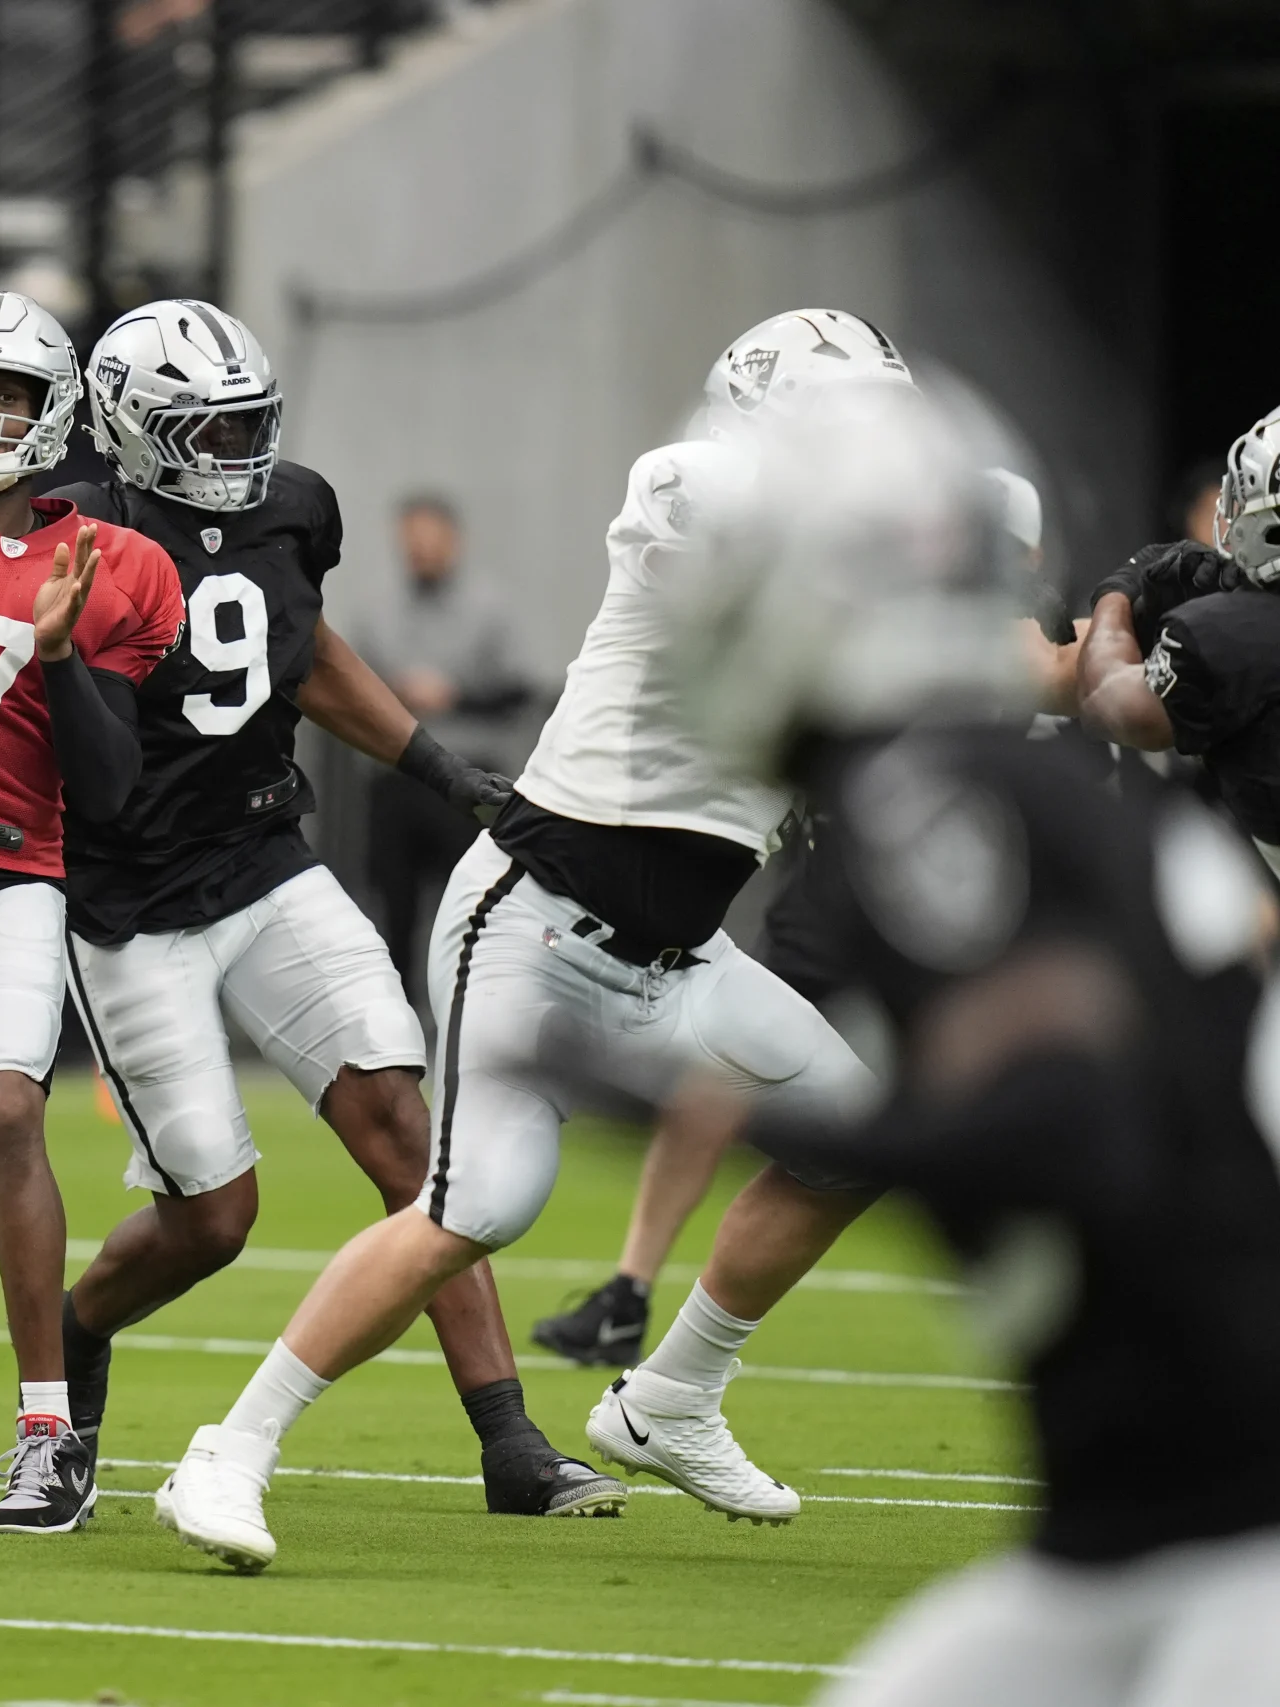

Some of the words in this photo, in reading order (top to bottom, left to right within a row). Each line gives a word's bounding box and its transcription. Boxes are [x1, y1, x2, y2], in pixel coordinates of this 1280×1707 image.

[100, 358, 128, 373] RAIDERS
[221, 376, 251, 387] RAIDERS
[181, 572, 272, 736] 9
